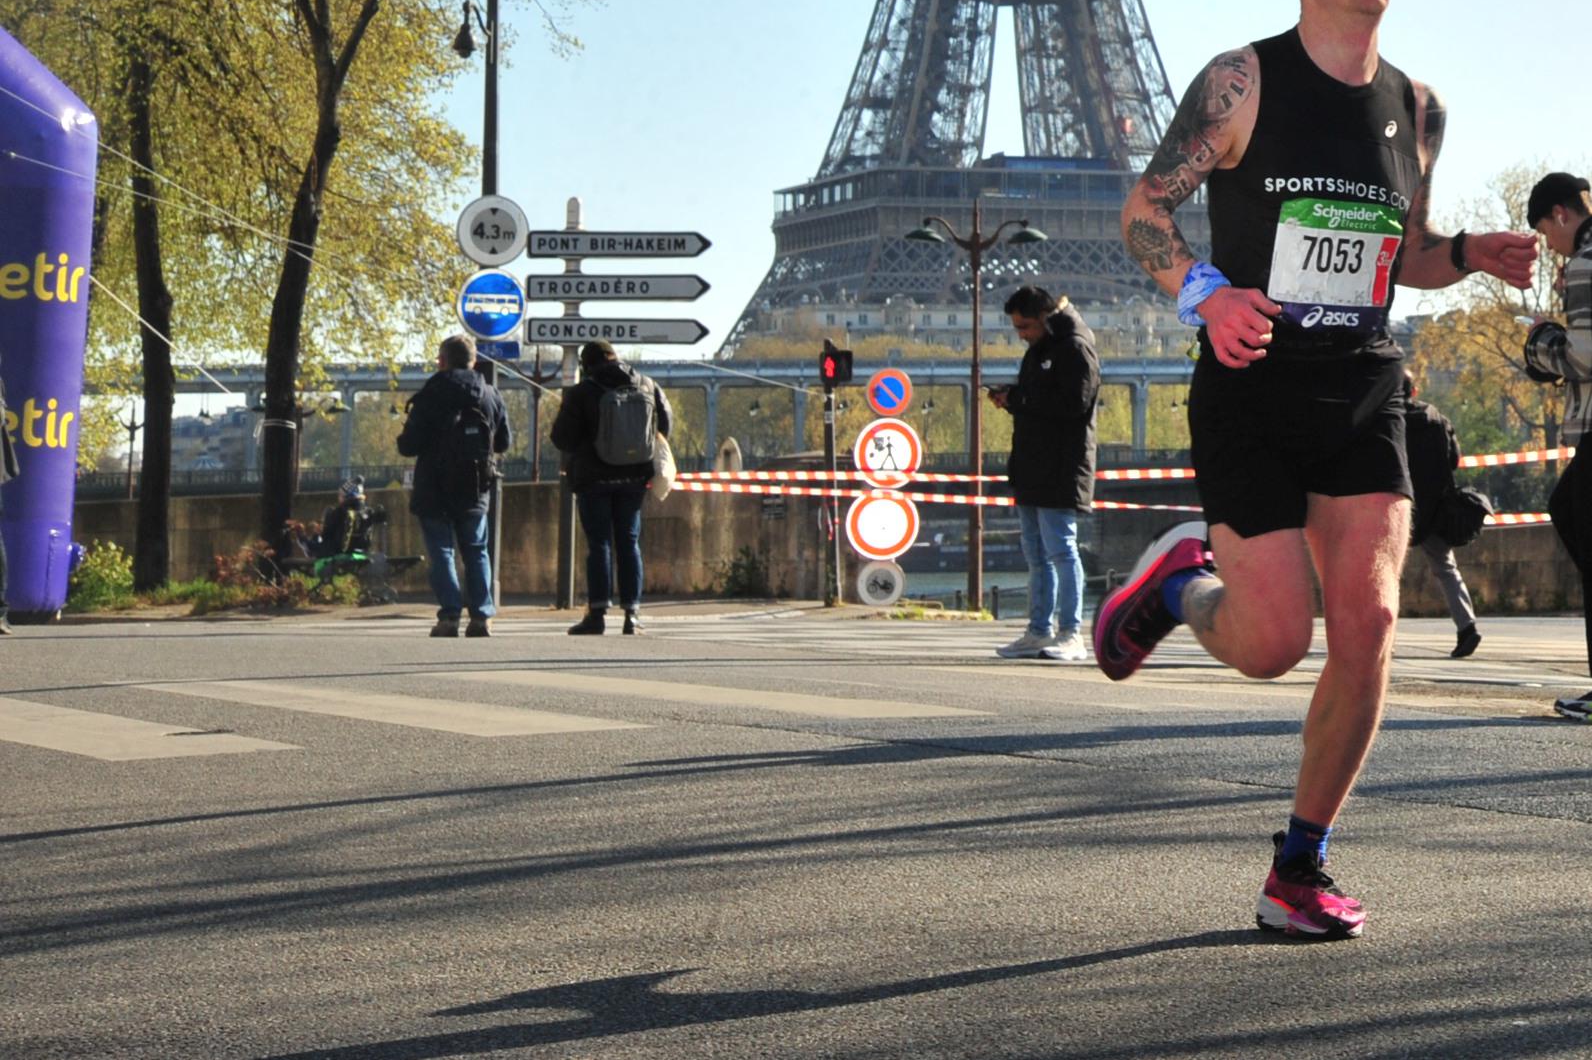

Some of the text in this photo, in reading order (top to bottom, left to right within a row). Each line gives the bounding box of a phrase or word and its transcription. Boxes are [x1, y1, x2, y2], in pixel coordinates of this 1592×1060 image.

[1312, 203, 1379, 221] Schneider
[1341, 221, 1377, 230] Electric
[537, 238, 686, 251] PONT BIR-HAKEIM
[1301, 235, 1365, 274] 7053
[537, 278, 650, 294] TROCADÉRO
[1322, 311, 1359, 326] asics
[537, 324, 638, 338] CONCORDE
